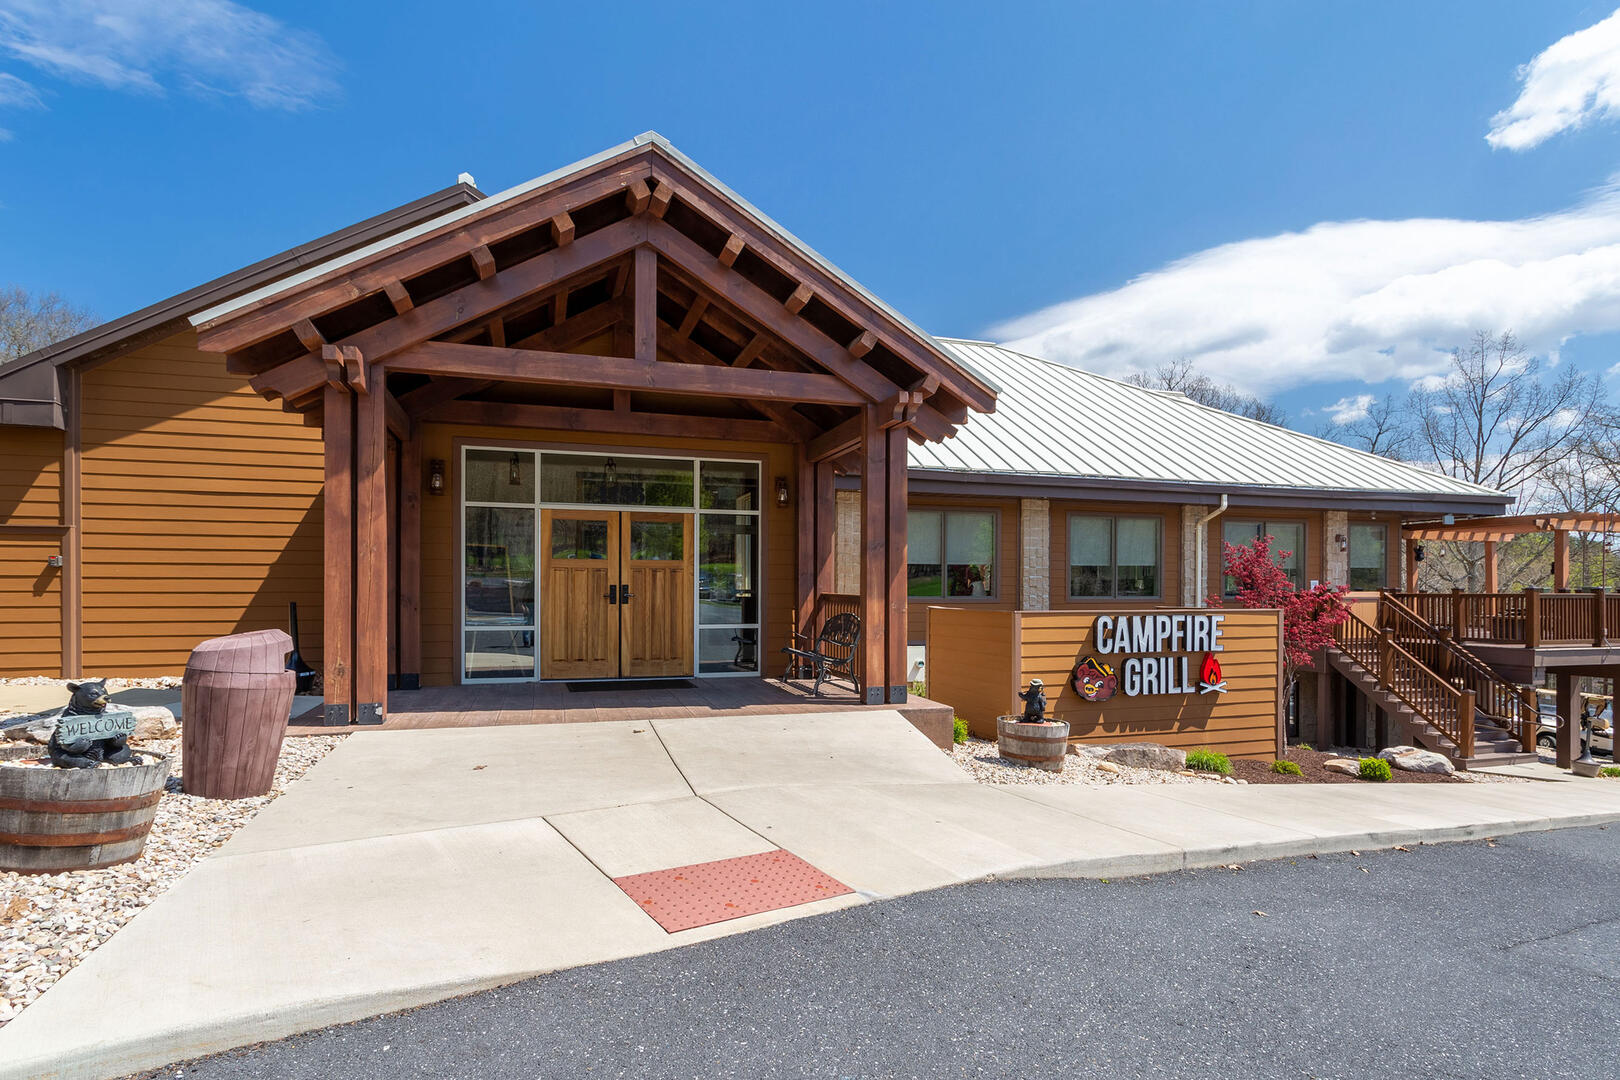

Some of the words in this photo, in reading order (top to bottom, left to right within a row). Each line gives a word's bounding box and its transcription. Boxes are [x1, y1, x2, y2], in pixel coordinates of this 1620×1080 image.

[1095, 615, 1225, 655] CAMPFIRE
[1123, 656, 1196, 697] GRILL
[66, 717, 132, 737] WELCOME
